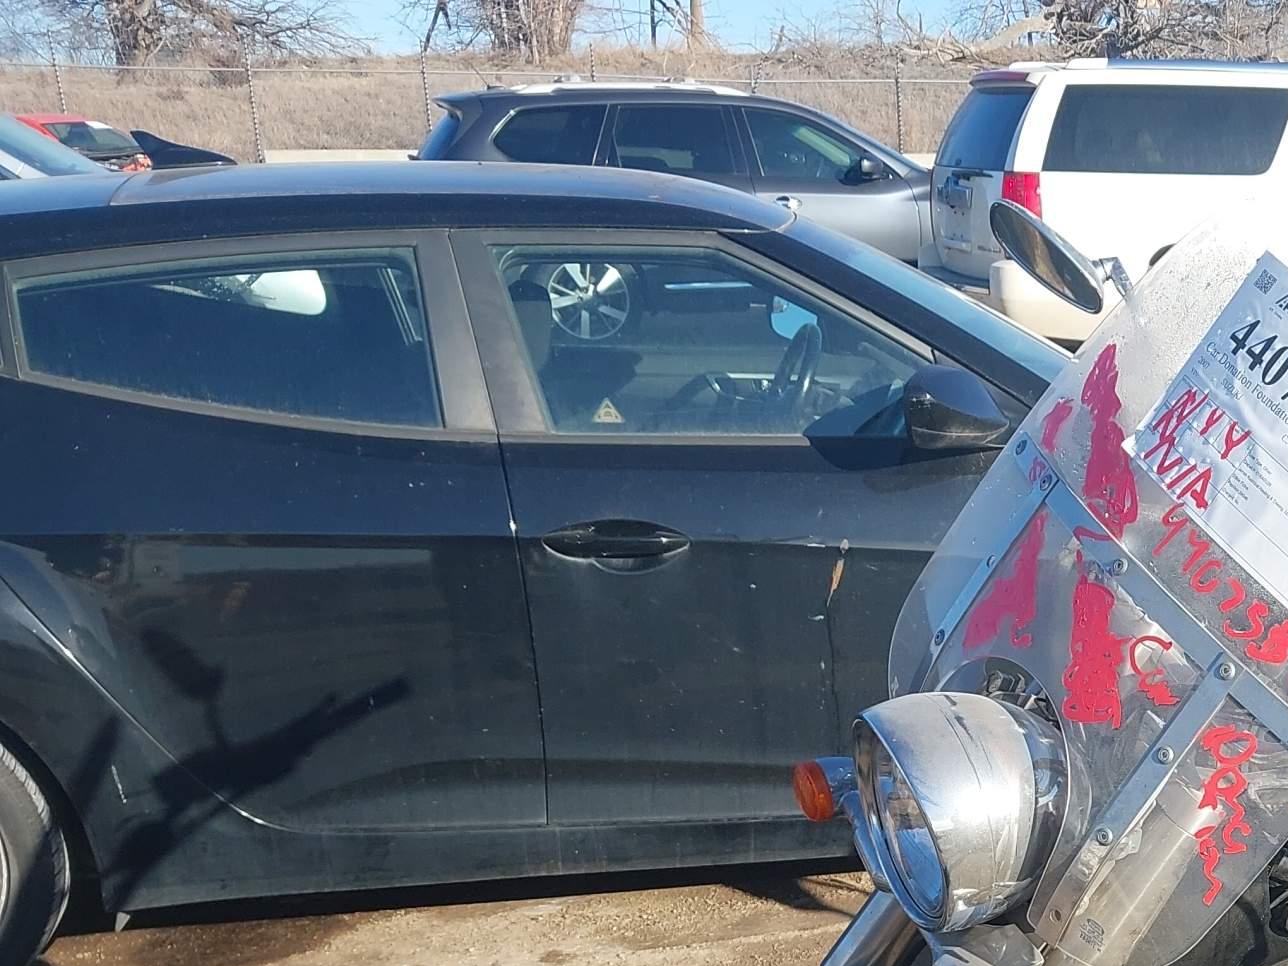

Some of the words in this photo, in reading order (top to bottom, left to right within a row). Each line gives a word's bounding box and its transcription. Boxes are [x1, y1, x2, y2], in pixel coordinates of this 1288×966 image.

[1206, 341, 1221, 360] Car
[1218, 350, 1253, 388] Donation
[1220, 378, 1242, 401] SUZUKI
[1220, 420, 1253, 460] Y
